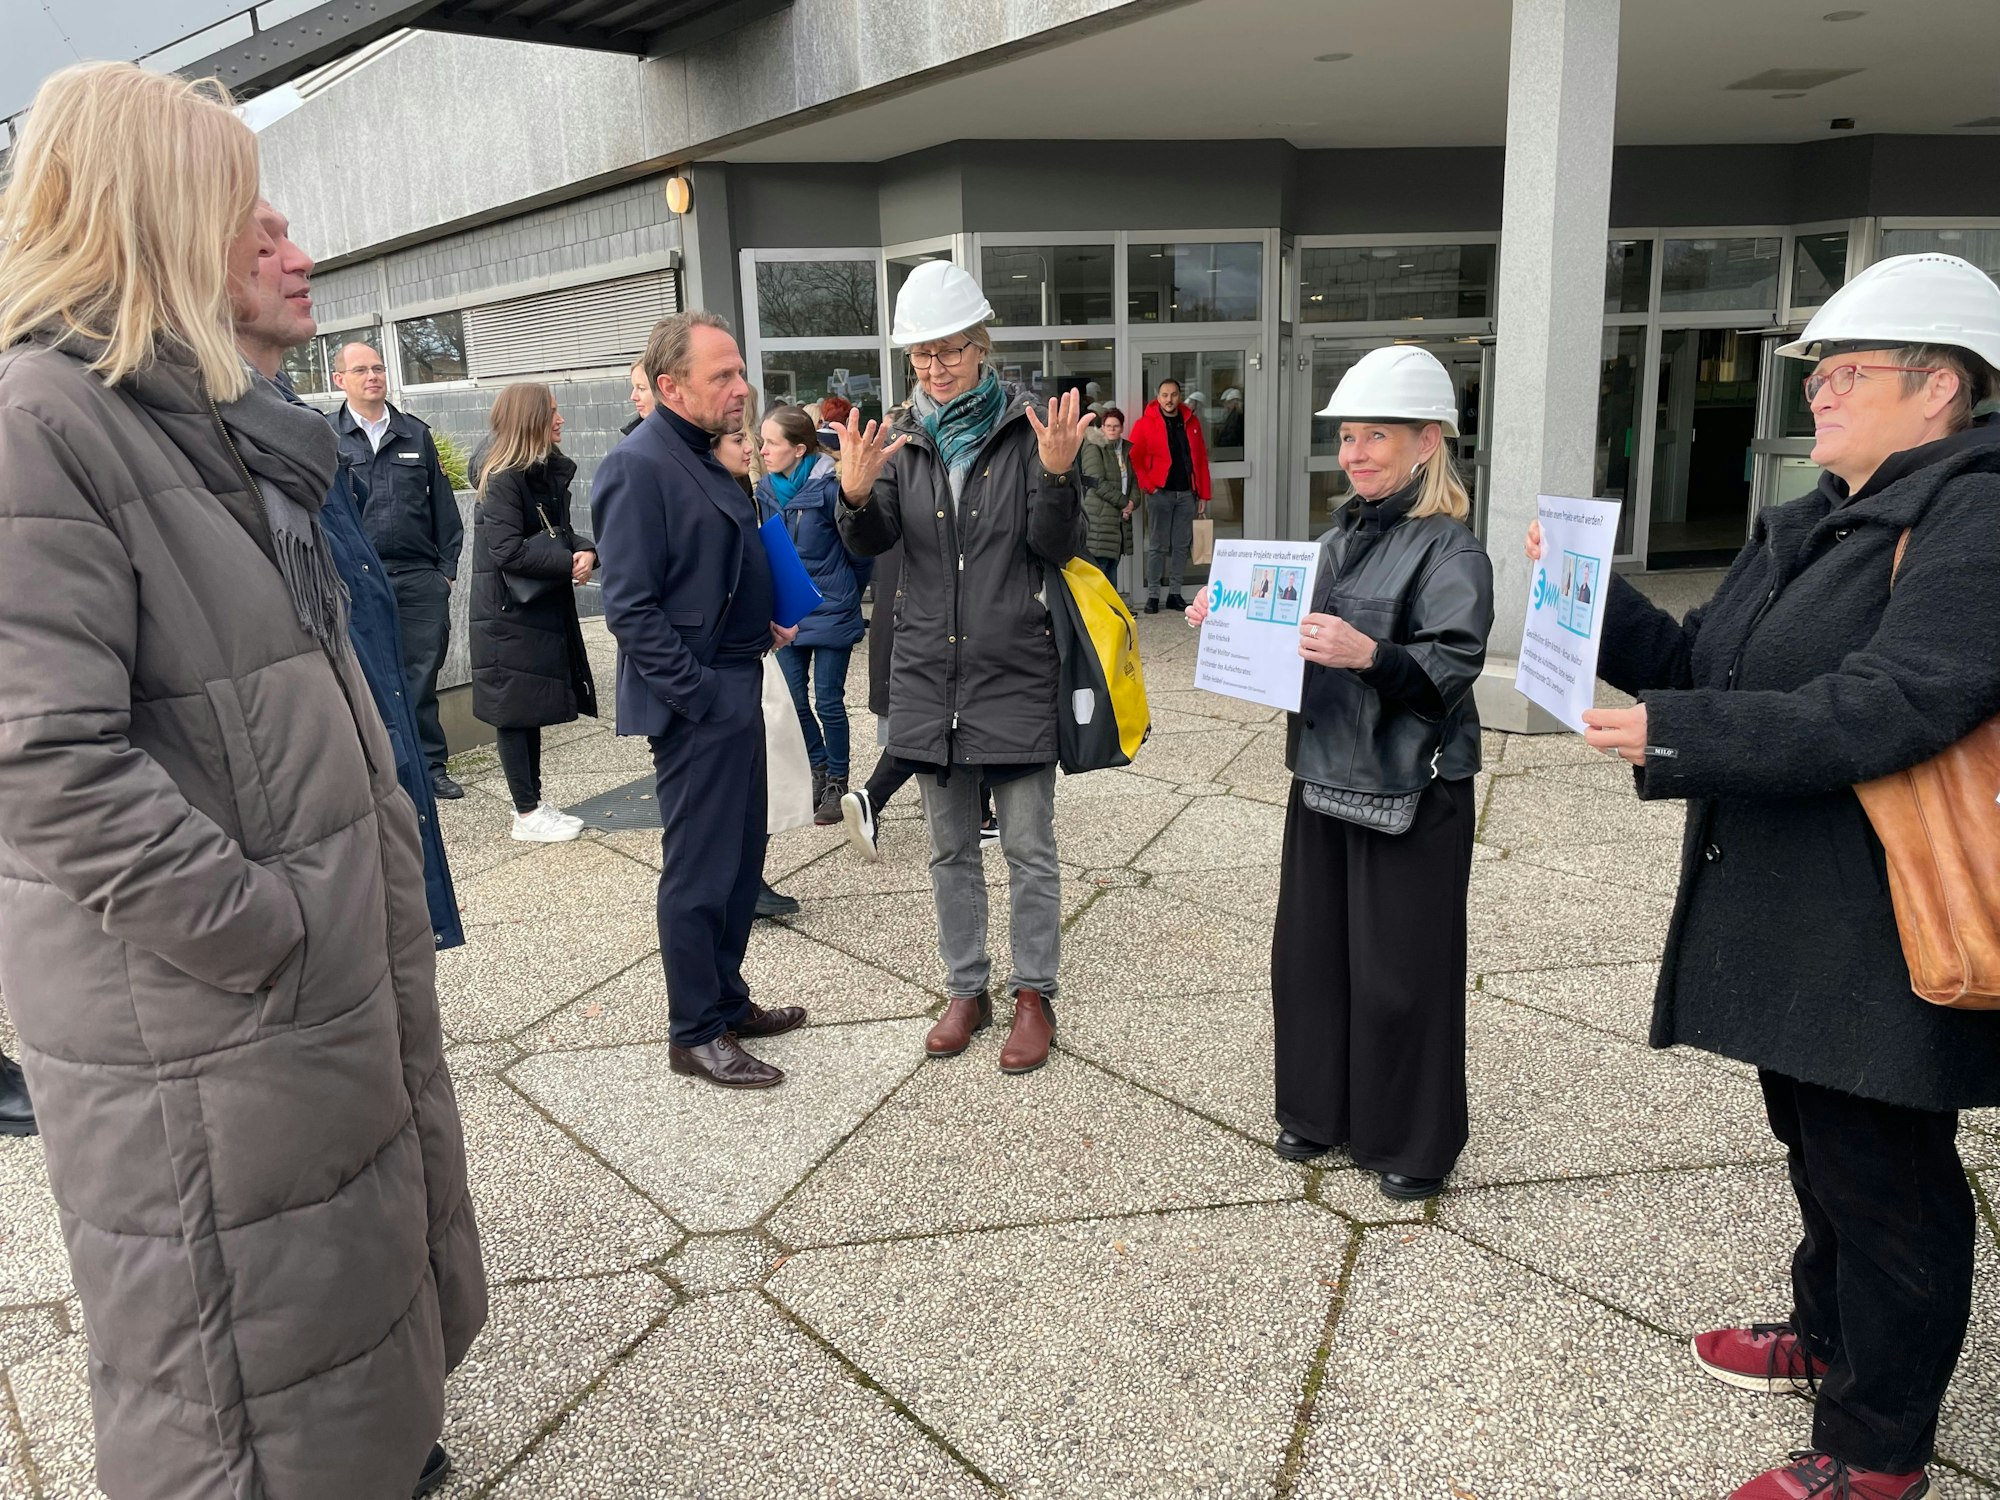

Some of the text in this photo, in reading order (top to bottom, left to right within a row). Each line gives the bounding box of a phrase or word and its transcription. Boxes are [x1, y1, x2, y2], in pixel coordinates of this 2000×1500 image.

[1585, 514, 1604, 526] werden?
[1253, 550, 1272, 560] Projekte
[1272, 551, 1291, 560] verkauft
[1291, 552, 1315, 562] werden?
[1209, 580, 1248, 613] SWM
[1533, 567, 1560, 611] SWM
